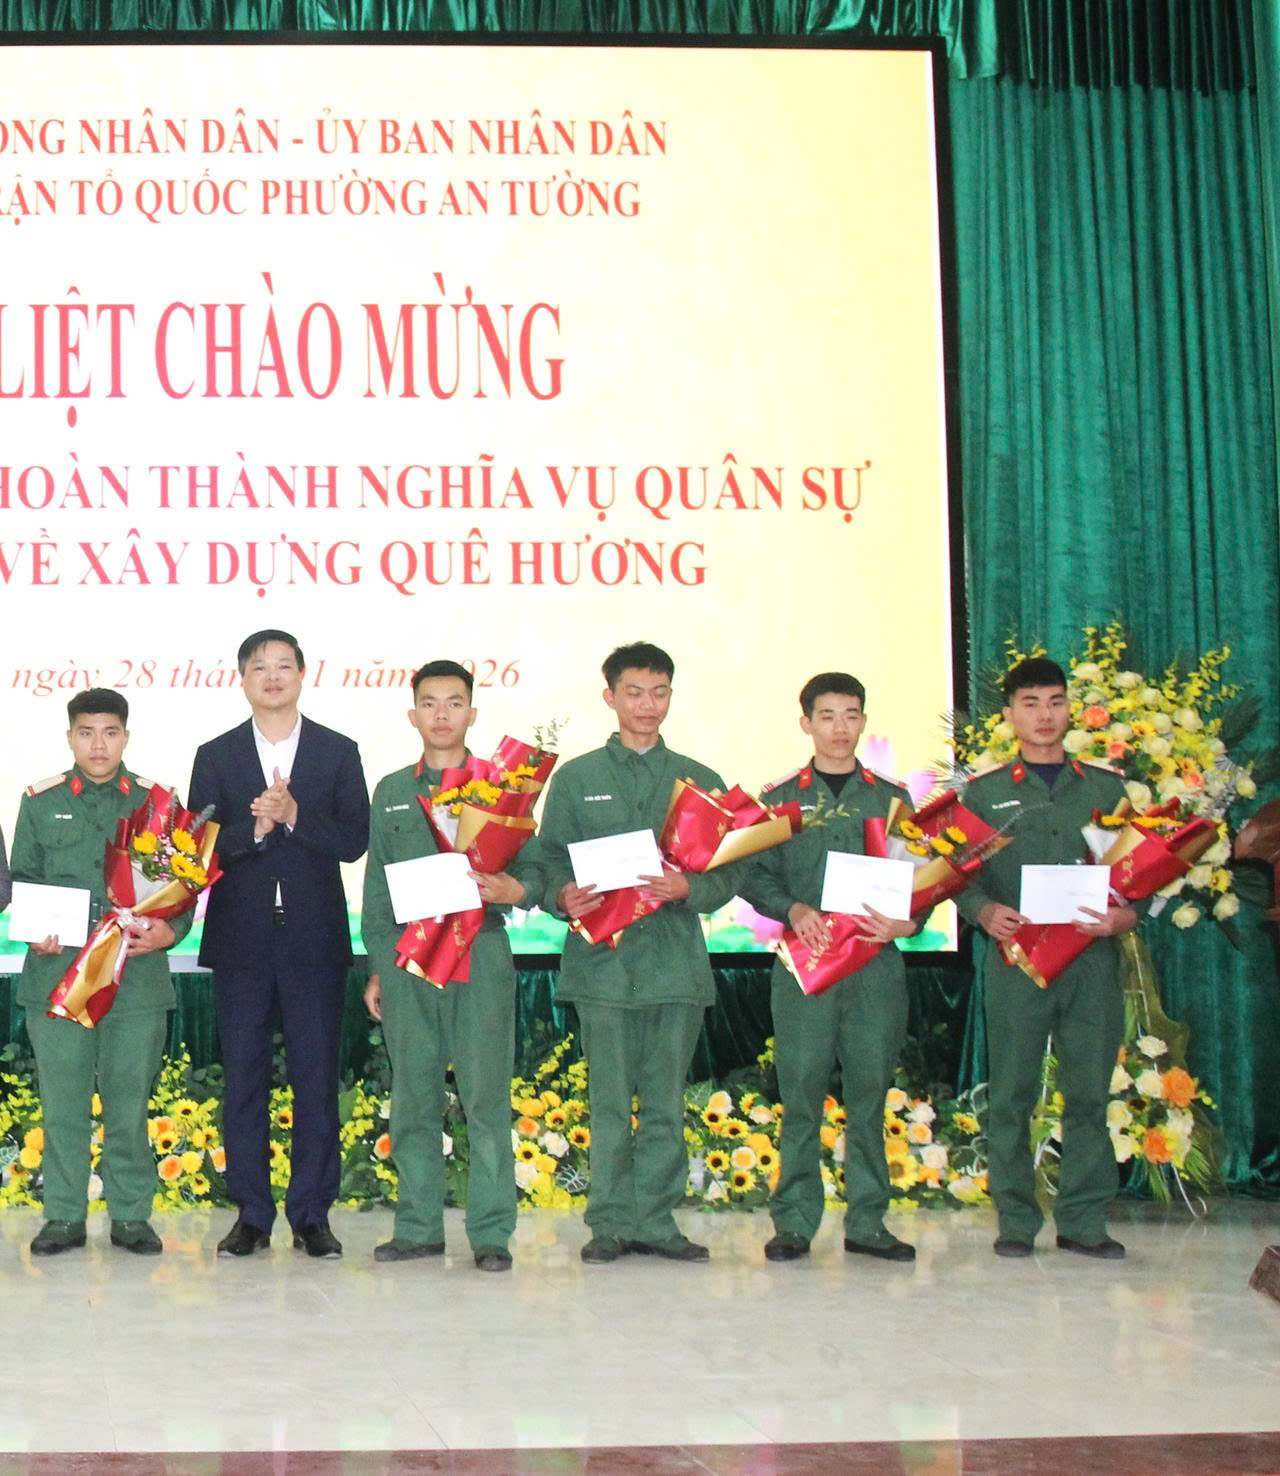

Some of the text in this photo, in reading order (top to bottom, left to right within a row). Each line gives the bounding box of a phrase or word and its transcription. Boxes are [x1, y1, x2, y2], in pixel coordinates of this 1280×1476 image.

[79, 107, 187, 154] NHÂN
[201, 107, 279, 154] DÂN
[316, 107, 366, 154] ỦY
[379, 119, 454, 154] BAN
[468, 109, 575, 155] NHÂN
[589, 109, 667, 156] DÂN
[70, 168, 123, 216] TỔ
[135, 168, 247, 224] QUỐC
[261, 169, 427, 216] PHƯỜNG
[439, 180, 489, 216] AN
[501, 170, 640, 217] TƯỜNG
[154, 271, 343, 400] CHÀO
[360, 271, 566, 401] MỪNG
[147, 452, 339, 509] THÀNH
[358, 452, 535, 510] NGHĨA
[546, 466, 617, 522] VỤ
[634, 452, 784, 521] QUÂN
[801, 459, 872, 524] SỰ
[77, 527, 190, 585] XÂY
[207, 533, 361, 599] DỰNG
[379, 527, 491, 597] QUÊ
[509, 533, 706, 587] HƯƠNG
[11, 659, 101, 697] ngày
[113, 659, 157, 689] 28
[170, 659, 245, 688] thán
[342, 659, 419, 688] năm
